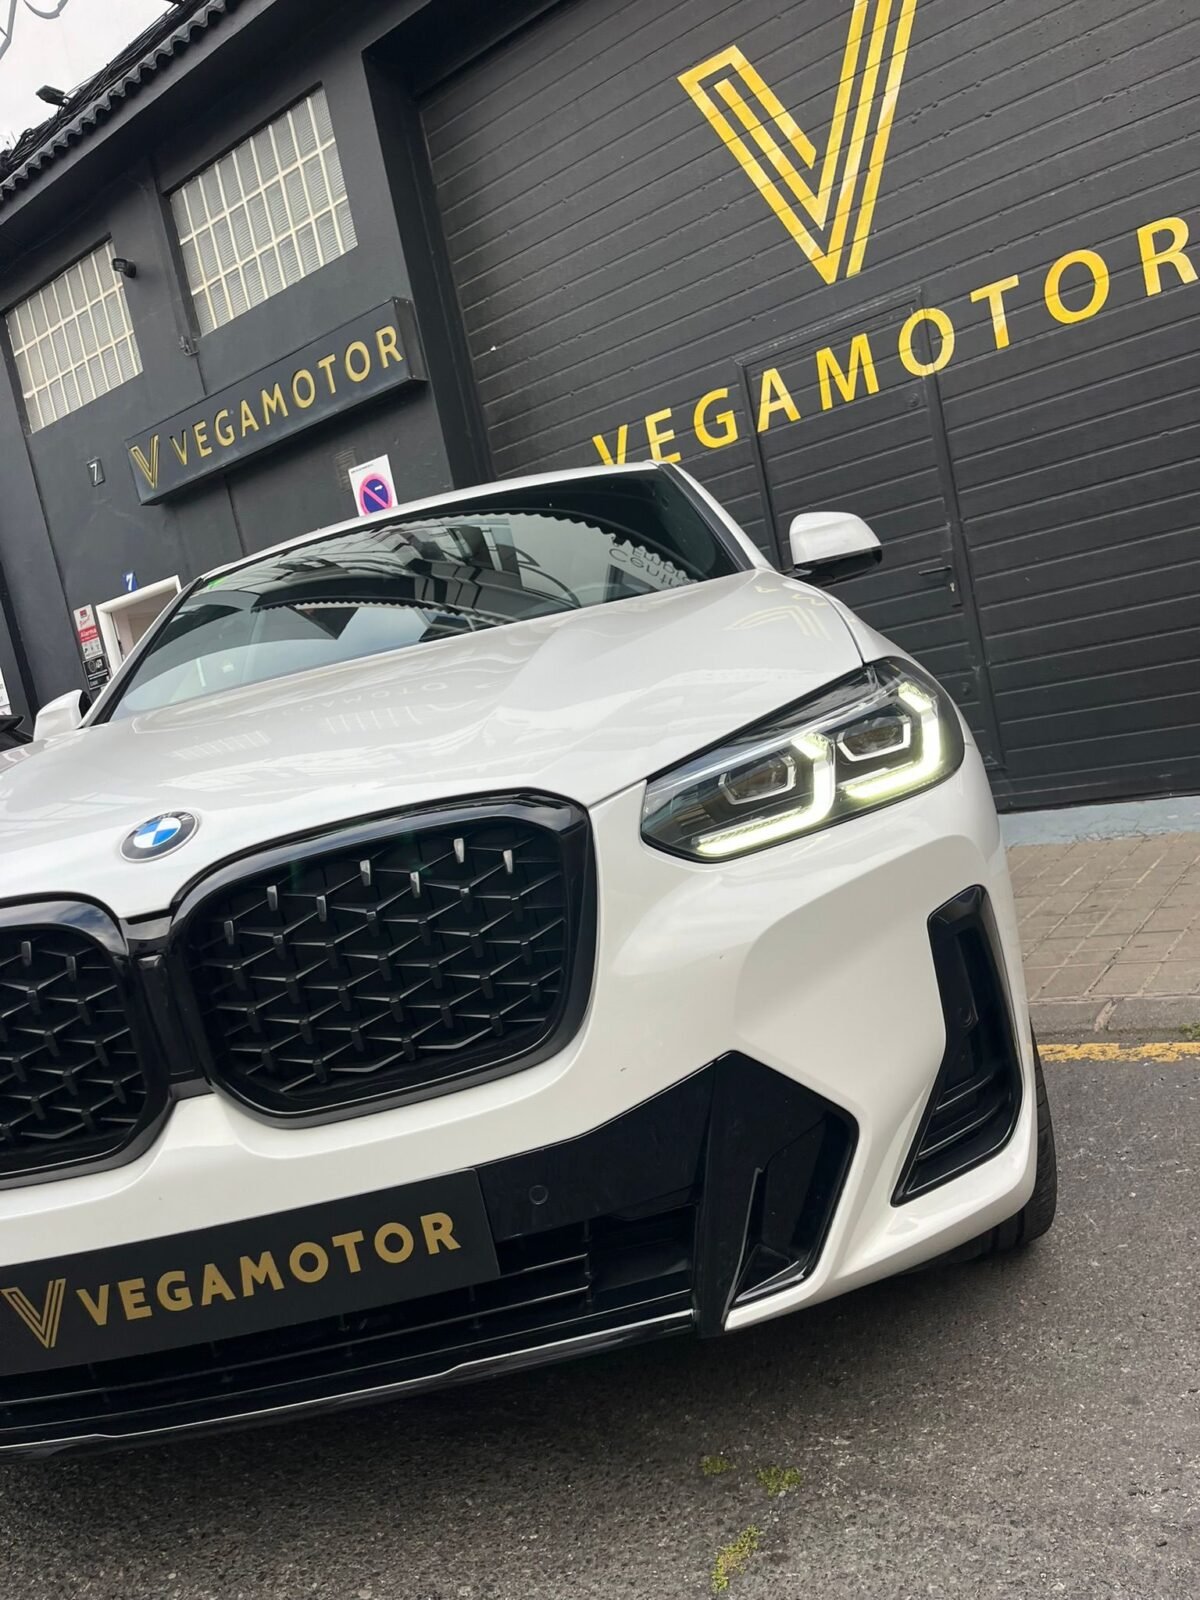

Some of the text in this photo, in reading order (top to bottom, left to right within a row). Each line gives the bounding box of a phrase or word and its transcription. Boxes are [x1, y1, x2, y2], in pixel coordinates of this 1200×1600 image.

[169, 325, 403, 466] VEGAMOTOR
[592, 217, 1199, 466] VEGAMOTOR
[89, 462, 98, 482] 7
[126, 572, 134, 592] 7
[76, 1211, 461, 1326] VEGAMOTOR
